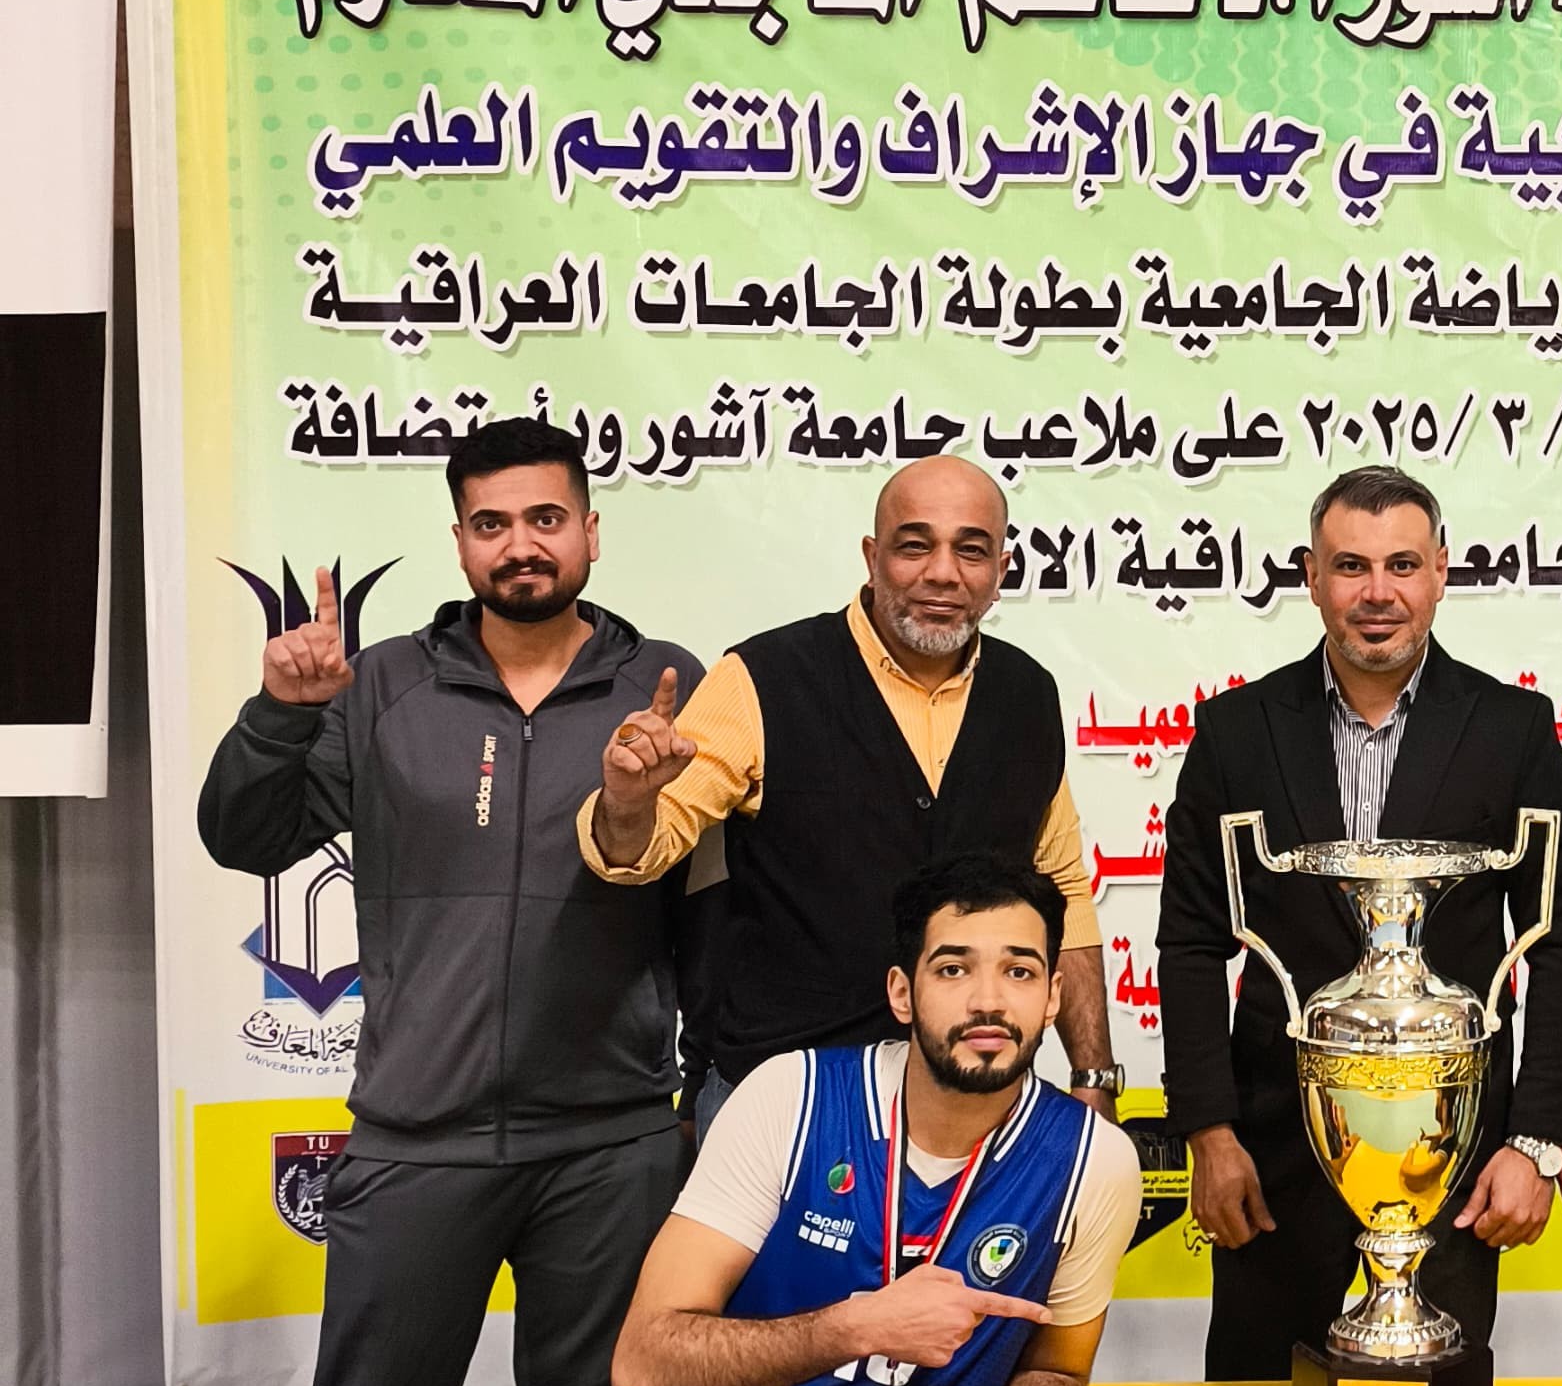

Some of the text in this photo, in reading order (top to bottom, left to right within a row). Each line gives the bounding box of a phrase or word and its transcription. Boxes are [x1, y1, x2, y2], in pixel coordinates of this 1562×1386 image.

[313, 86, 535, 213] العلمي
[552, 85, 863, 203] والتقويم
[877, 86, 1152, 205] الإشراف
[1154, 93, 1324, 204] جهاز
[1338, 91, 1440, 221] في
[301, 249, 602, 350] العراقية
[632, 255, 923, 353] الجامعات
[939, 250, 1122, 355] بطولة
[1135, 254, 1393, 355] الجامعية
[630, 383, 773, 477] آشور
[983, 393, 1157, 483] ملاعب
[1172, 393, 1284, 480] على
[482, 733, 498, 763] SPORT
[475, 775, 493, 827] adidas
[245, 1052, 313, 1075] UNIVERSITY
[315, 1066, 331, 1076] OF
[306, 1135, 331, 1151] TU
[804, 1210, 856, 1236] capelli
